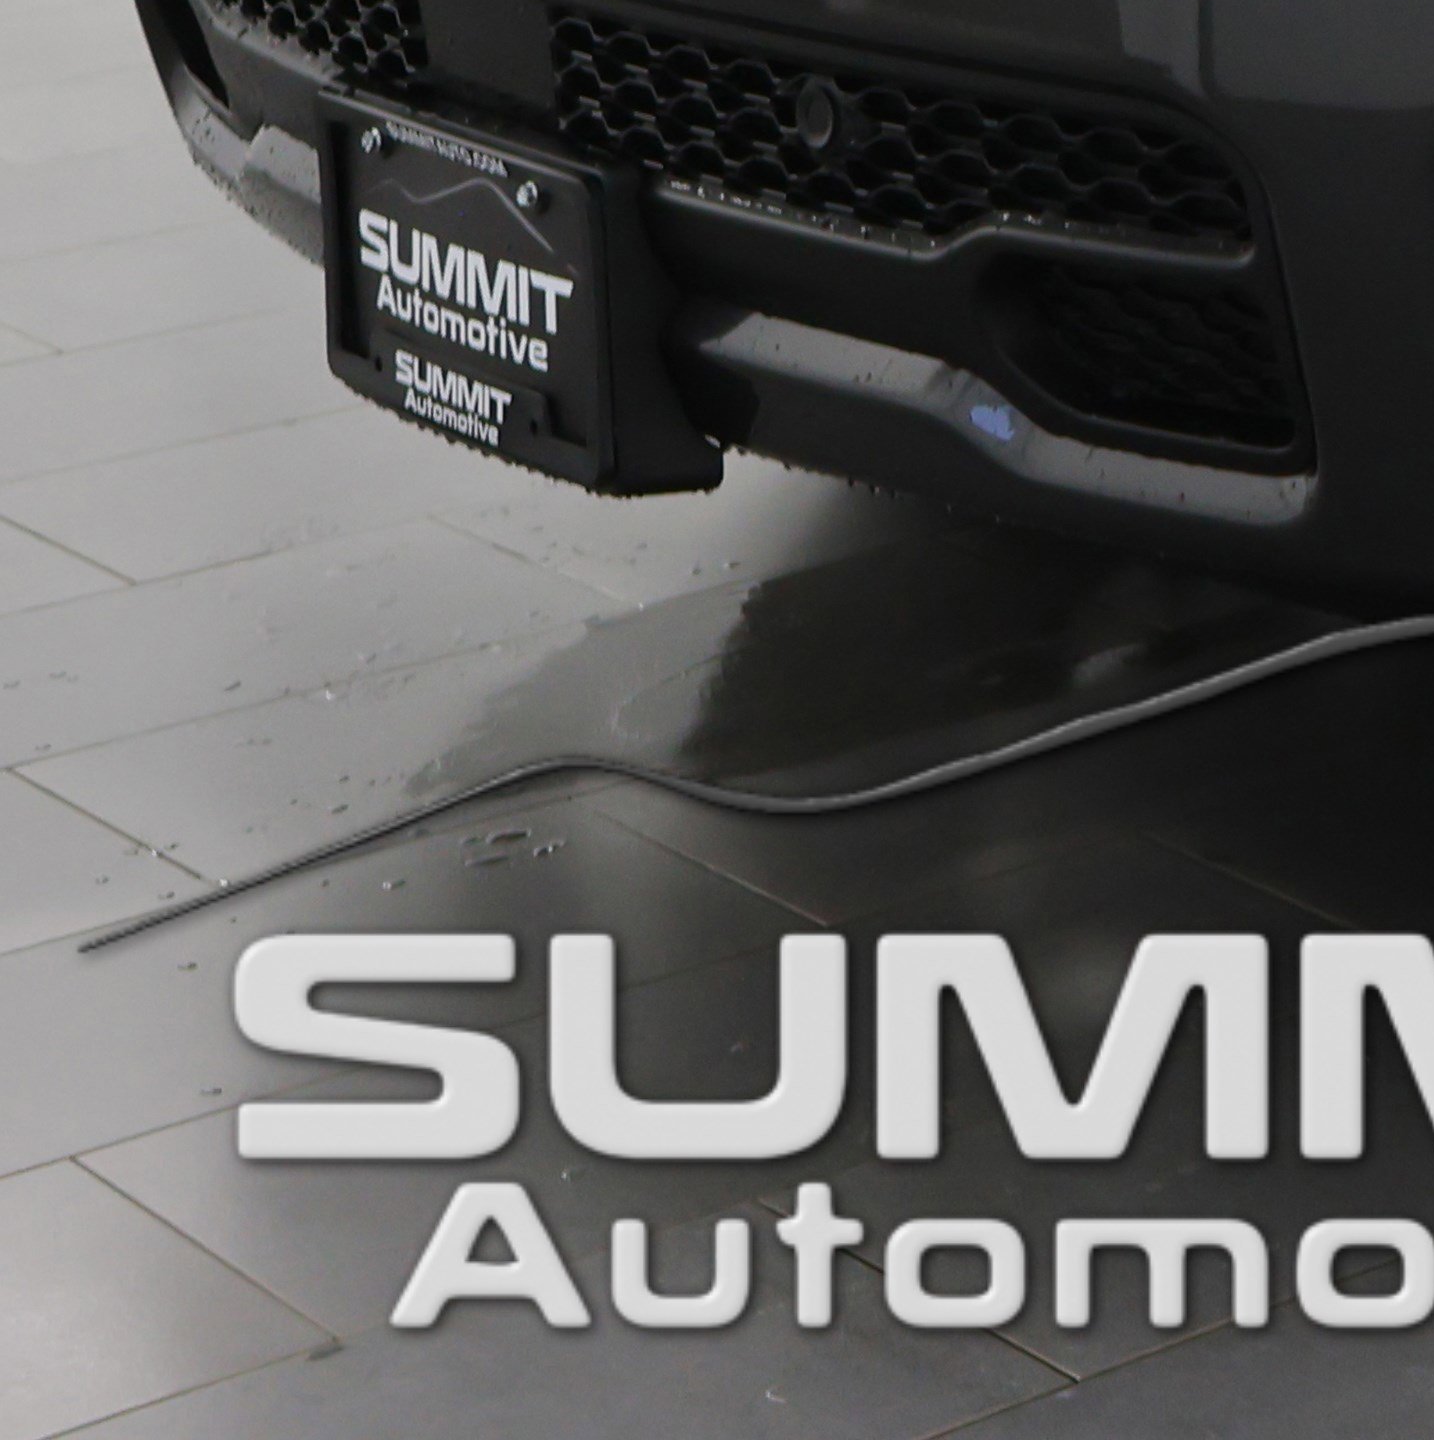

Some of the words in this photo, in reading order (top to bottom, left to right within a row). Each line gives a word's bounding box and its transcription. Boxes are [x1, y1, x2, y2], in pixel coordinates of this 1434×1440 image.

[358, 208, 574, 335] SUMMIT
[376, 274, 549, 373] Automotive
[394, 349, 513, 424] SUMMIT
[404, 387, 499, 447] Automotive
